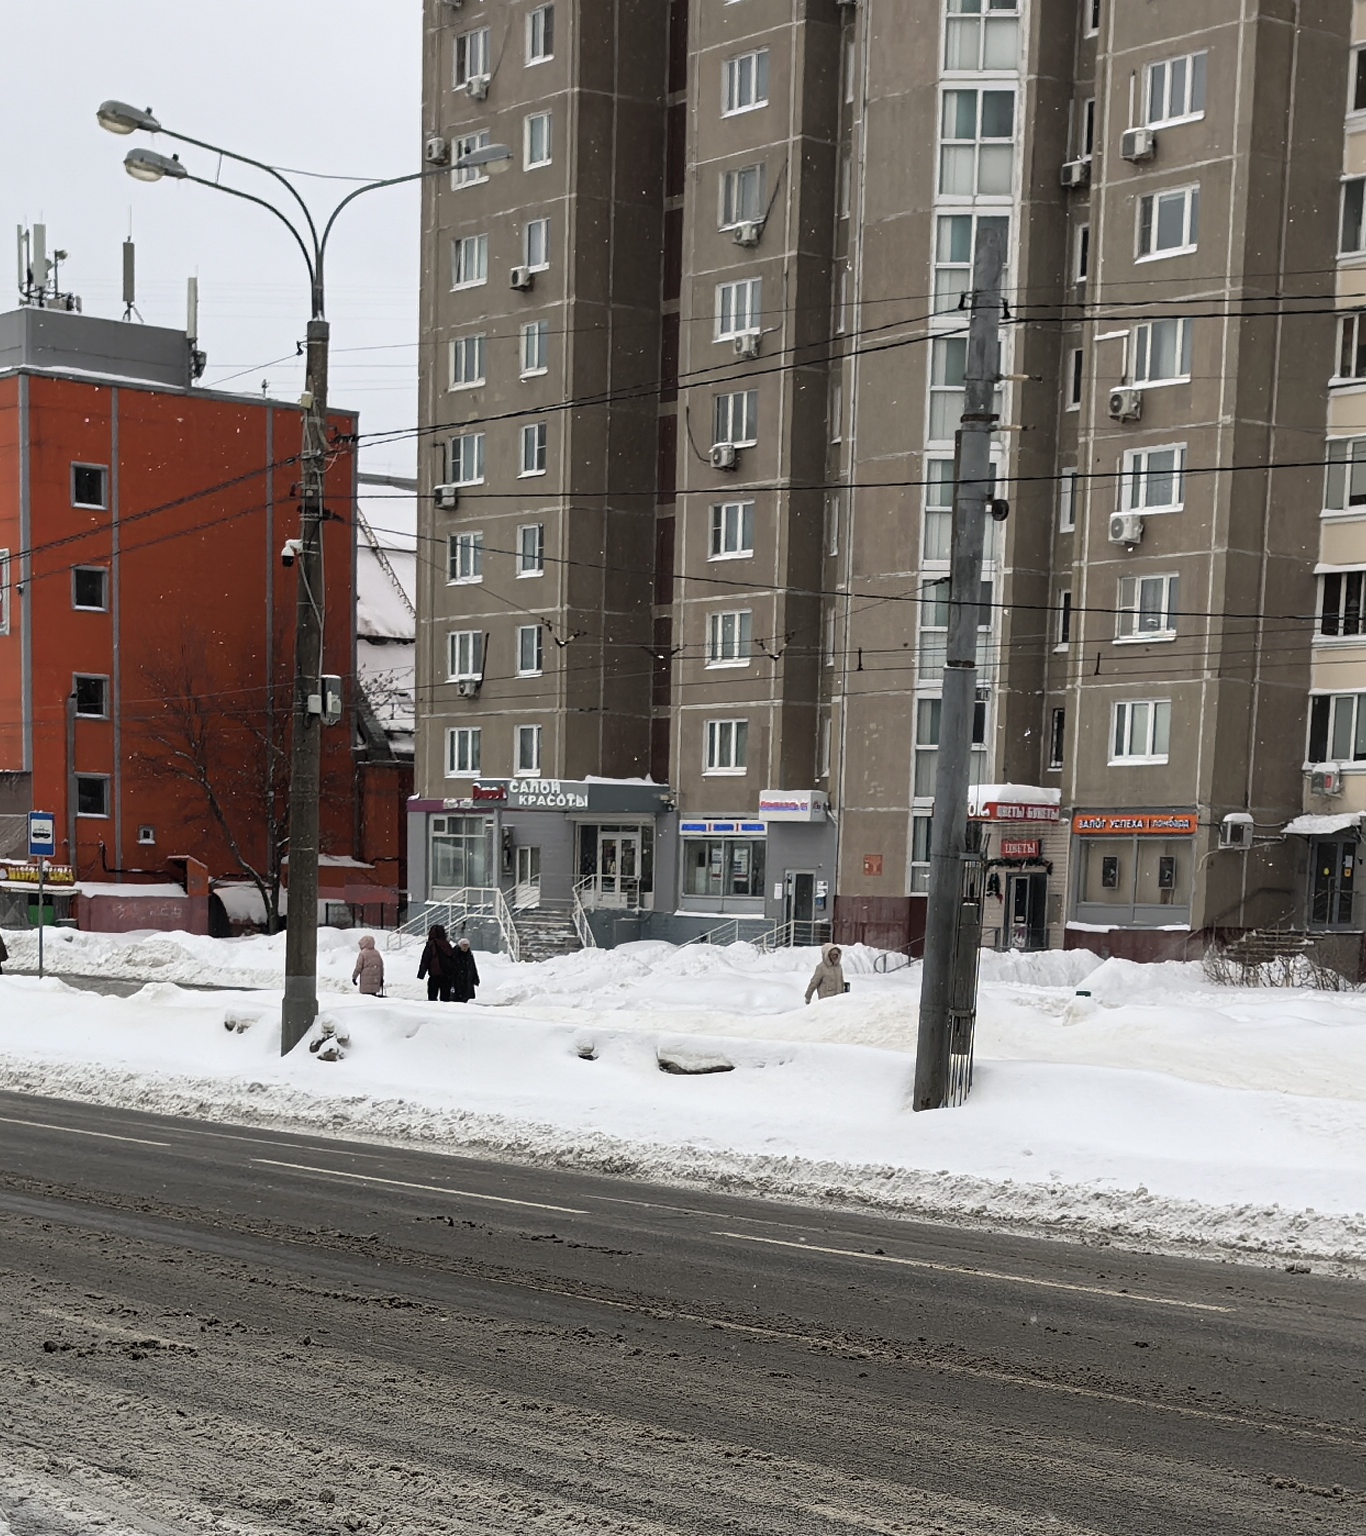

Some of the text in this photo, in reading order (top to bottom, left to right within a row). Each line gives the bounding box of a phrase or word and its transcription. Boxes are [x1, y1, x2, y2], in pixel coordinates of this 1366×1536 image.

[509, 780, 561, 794] САЛОН
[518, 794, 588, 807] КРАСОТЫ
[1110, 819, 1143, 829] УСПЕХА
[1005, 843, 1036, 854] ЦВЕТЫ
